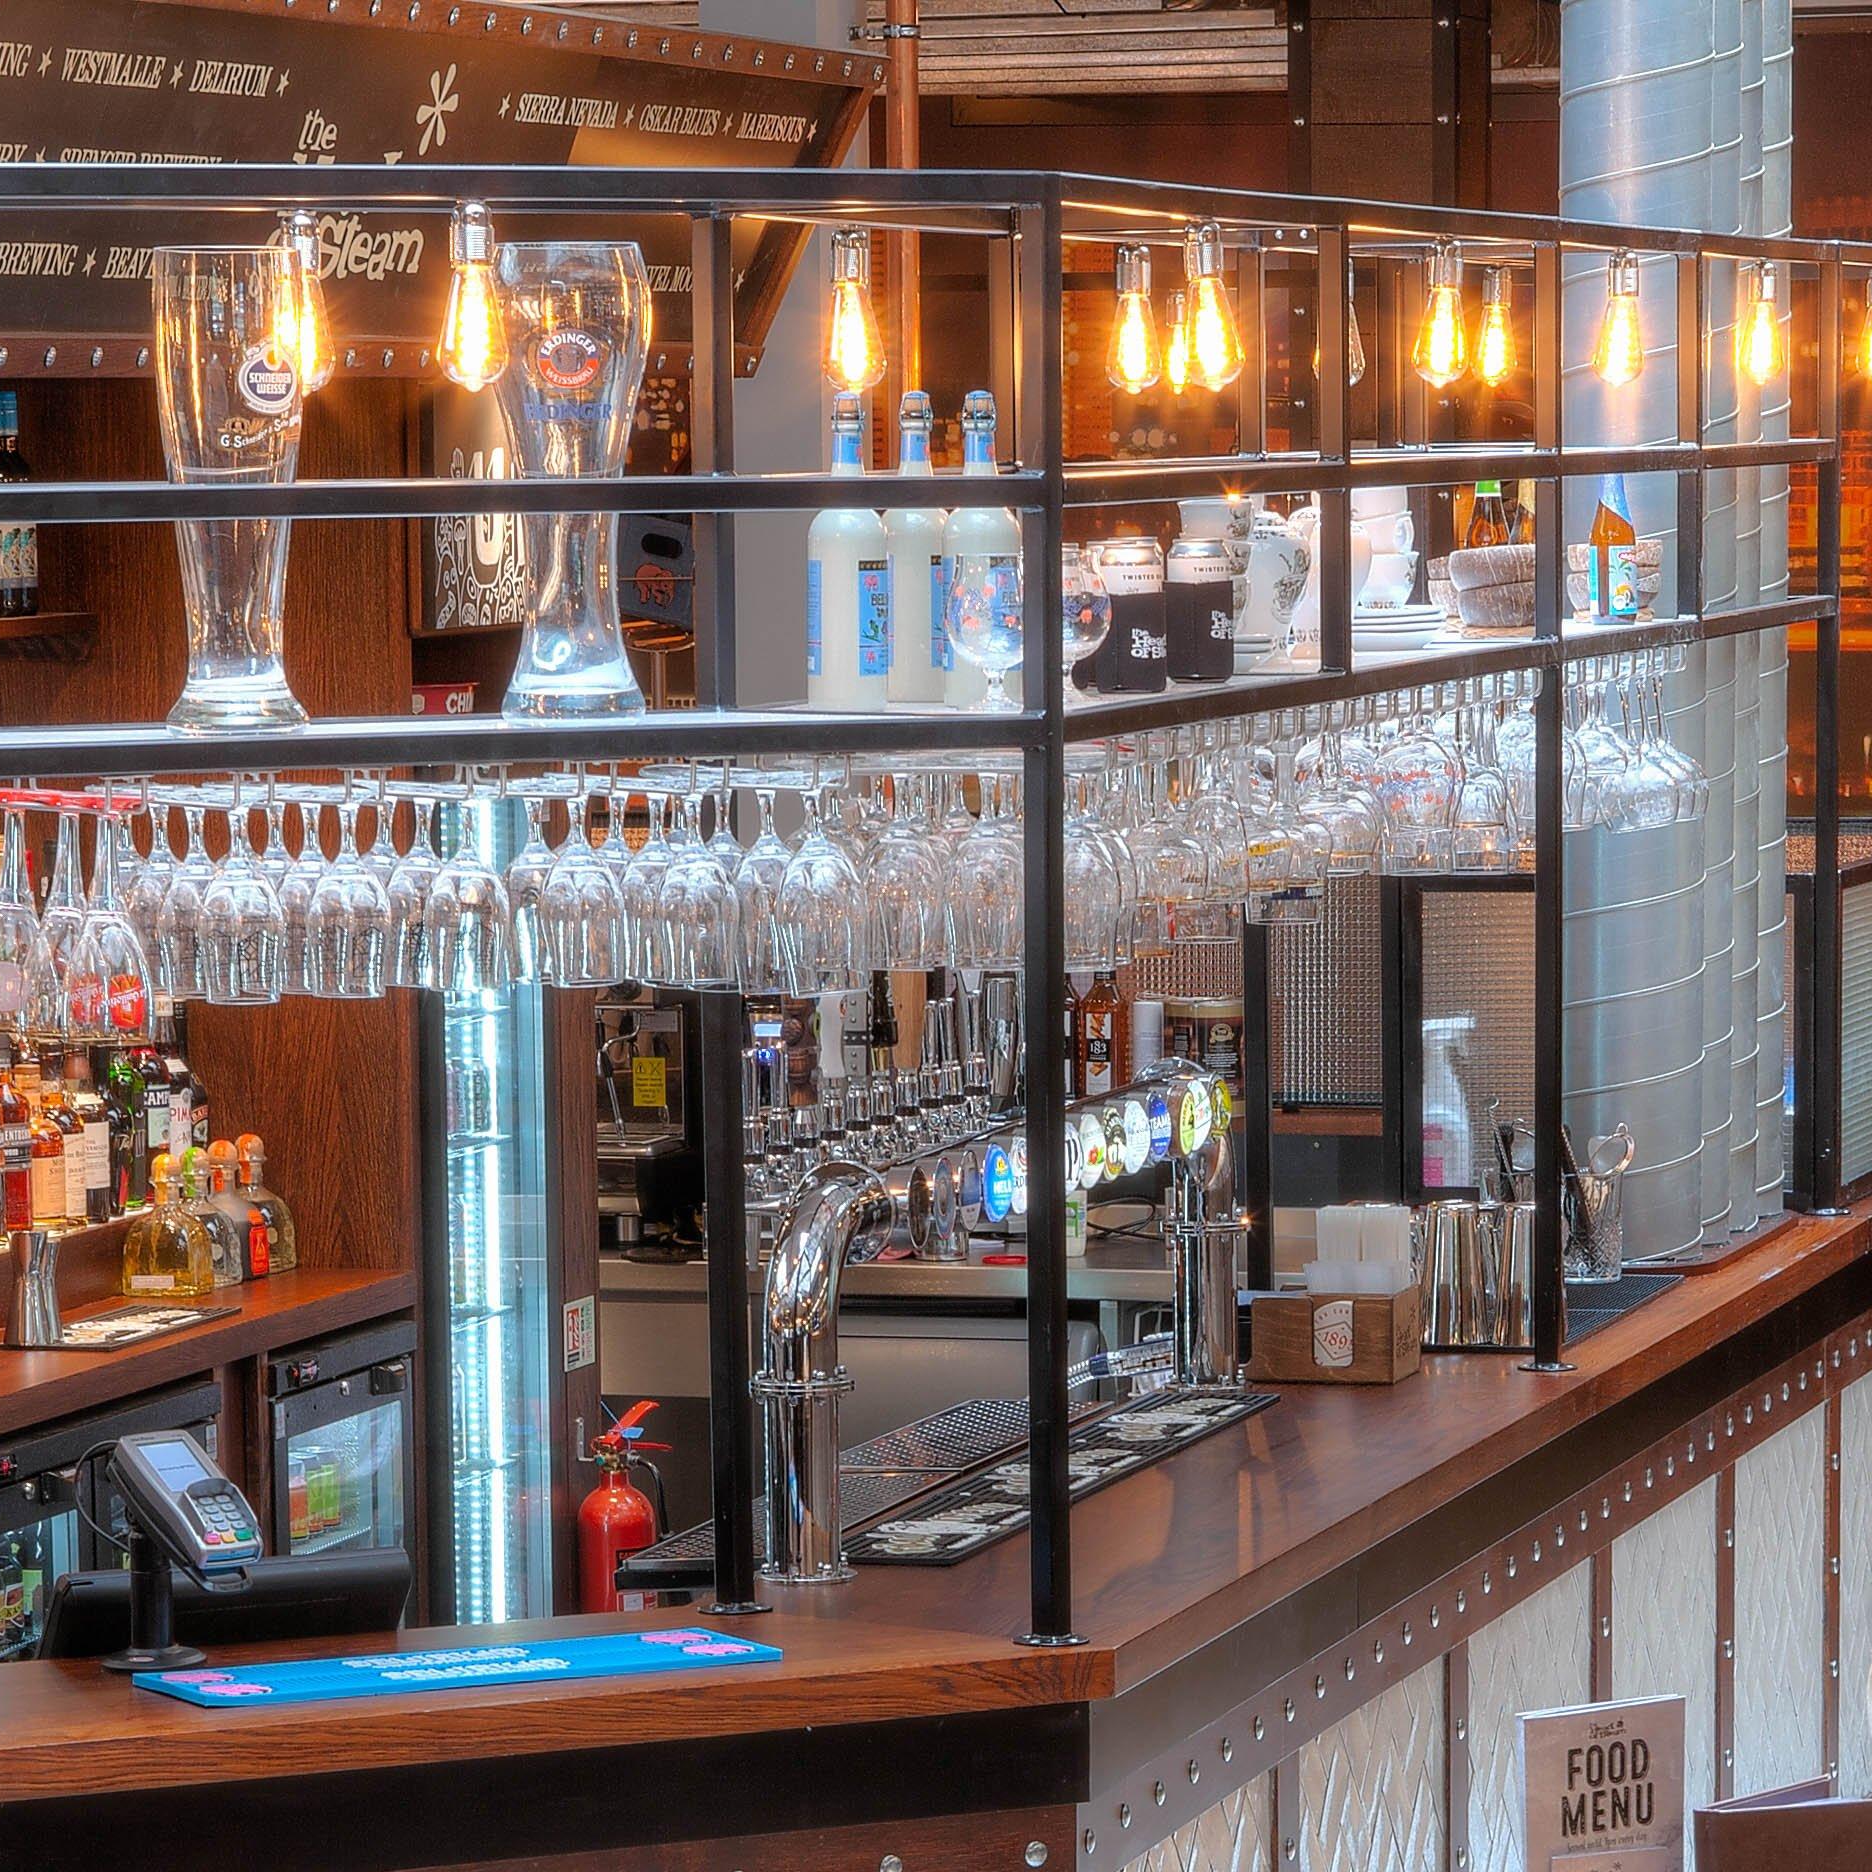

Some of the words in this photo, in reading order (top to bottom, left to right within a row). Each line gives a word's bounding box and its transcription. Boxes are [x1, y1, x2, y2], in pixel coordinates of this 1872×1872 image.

[61, 48, 166, 90] WESTMALLE
[189, 61, 274, 97] DELIRIUM
[514, 92, 572, 127] SIERRA
[567, 96, 620, 129] NEVADA
[638, 103, 684, 134] OSKAR
[679, 107, 721, 137] BLUES
[736, 112, 808, 143] MAREDSOUS
[297, 109, 338, 151] the
[541, 331, 598, 357] ERDINGER
[249, 372, 292, 384] SCHNEIDER
[256, 383, 287, 395] WEISSE
[523, 401, 613, 423] ERDINGER
[1193, 566, 1225, 574] TWISTED
[1566, 1738, 1653, 1791] FOOD
[1560, 1782, 1655, 1838] MENU
